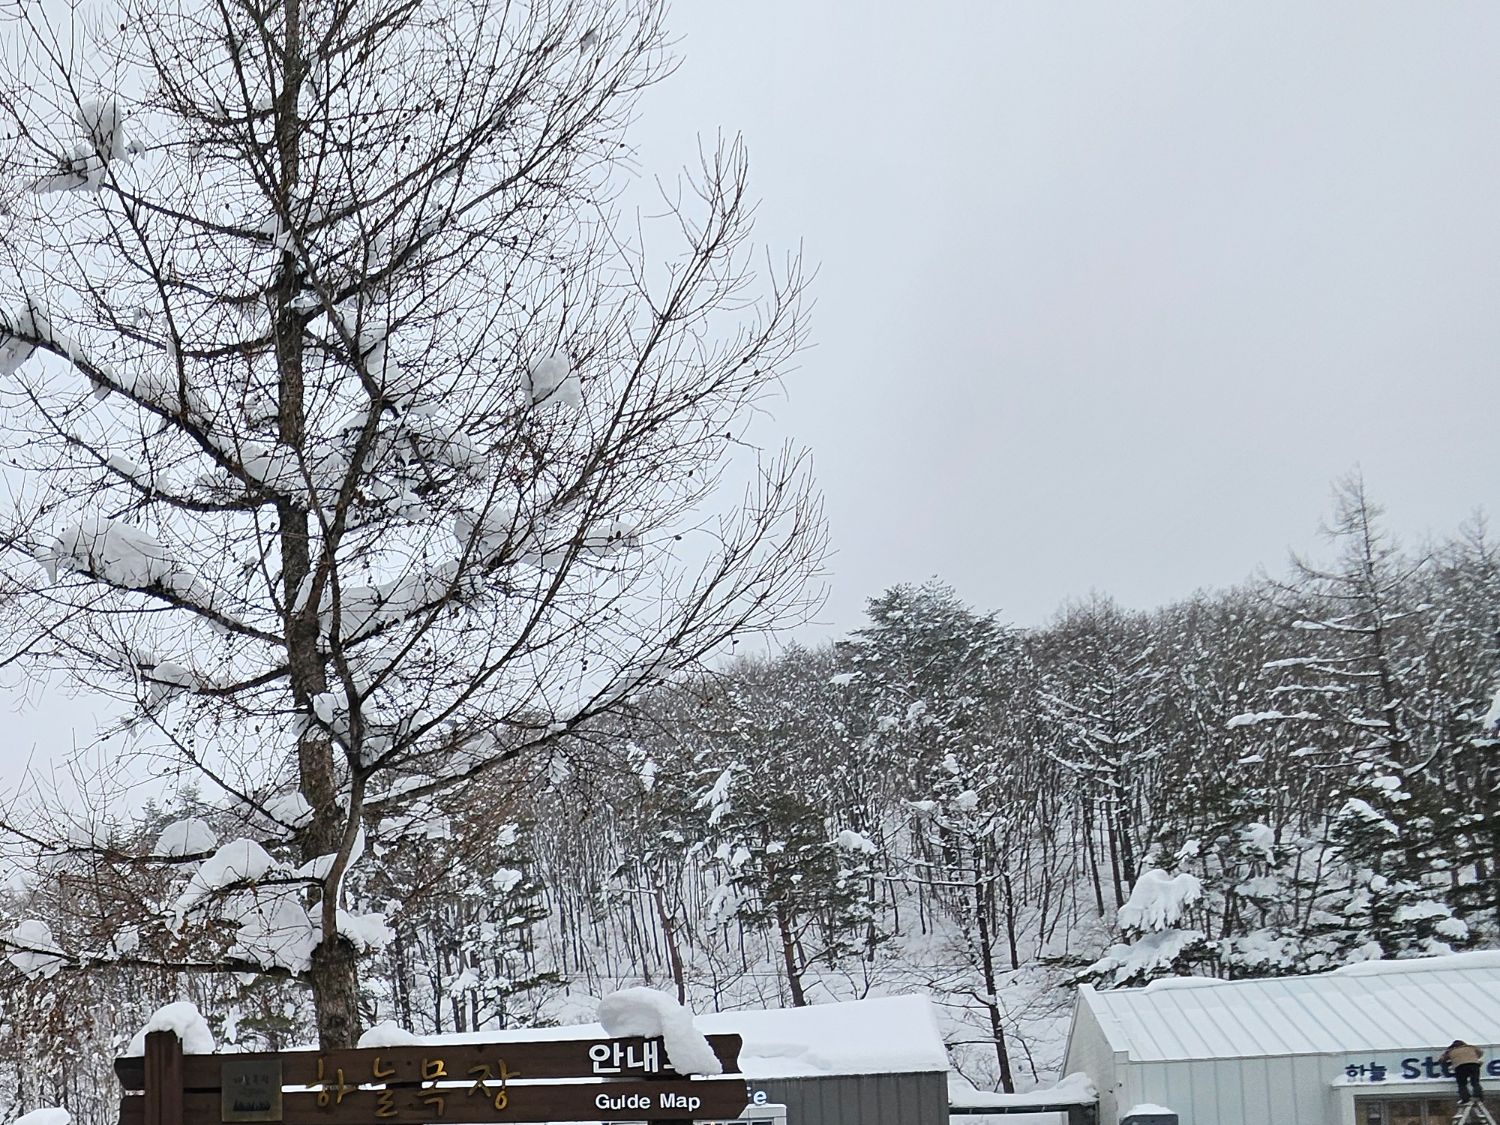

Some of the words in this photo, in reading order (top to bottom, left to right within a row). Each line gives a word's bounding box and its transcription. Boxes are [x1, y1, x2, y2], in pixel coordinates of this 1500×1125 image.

[588, 1041, 675, 1073] 안내
[1345, 1061, 1387, 1082] 하늘
[305, 1057, 521, 1118] 하늘목장
[595, 1094, 651, 1110] Guide
[659, 1093, 701, 1112] Map
